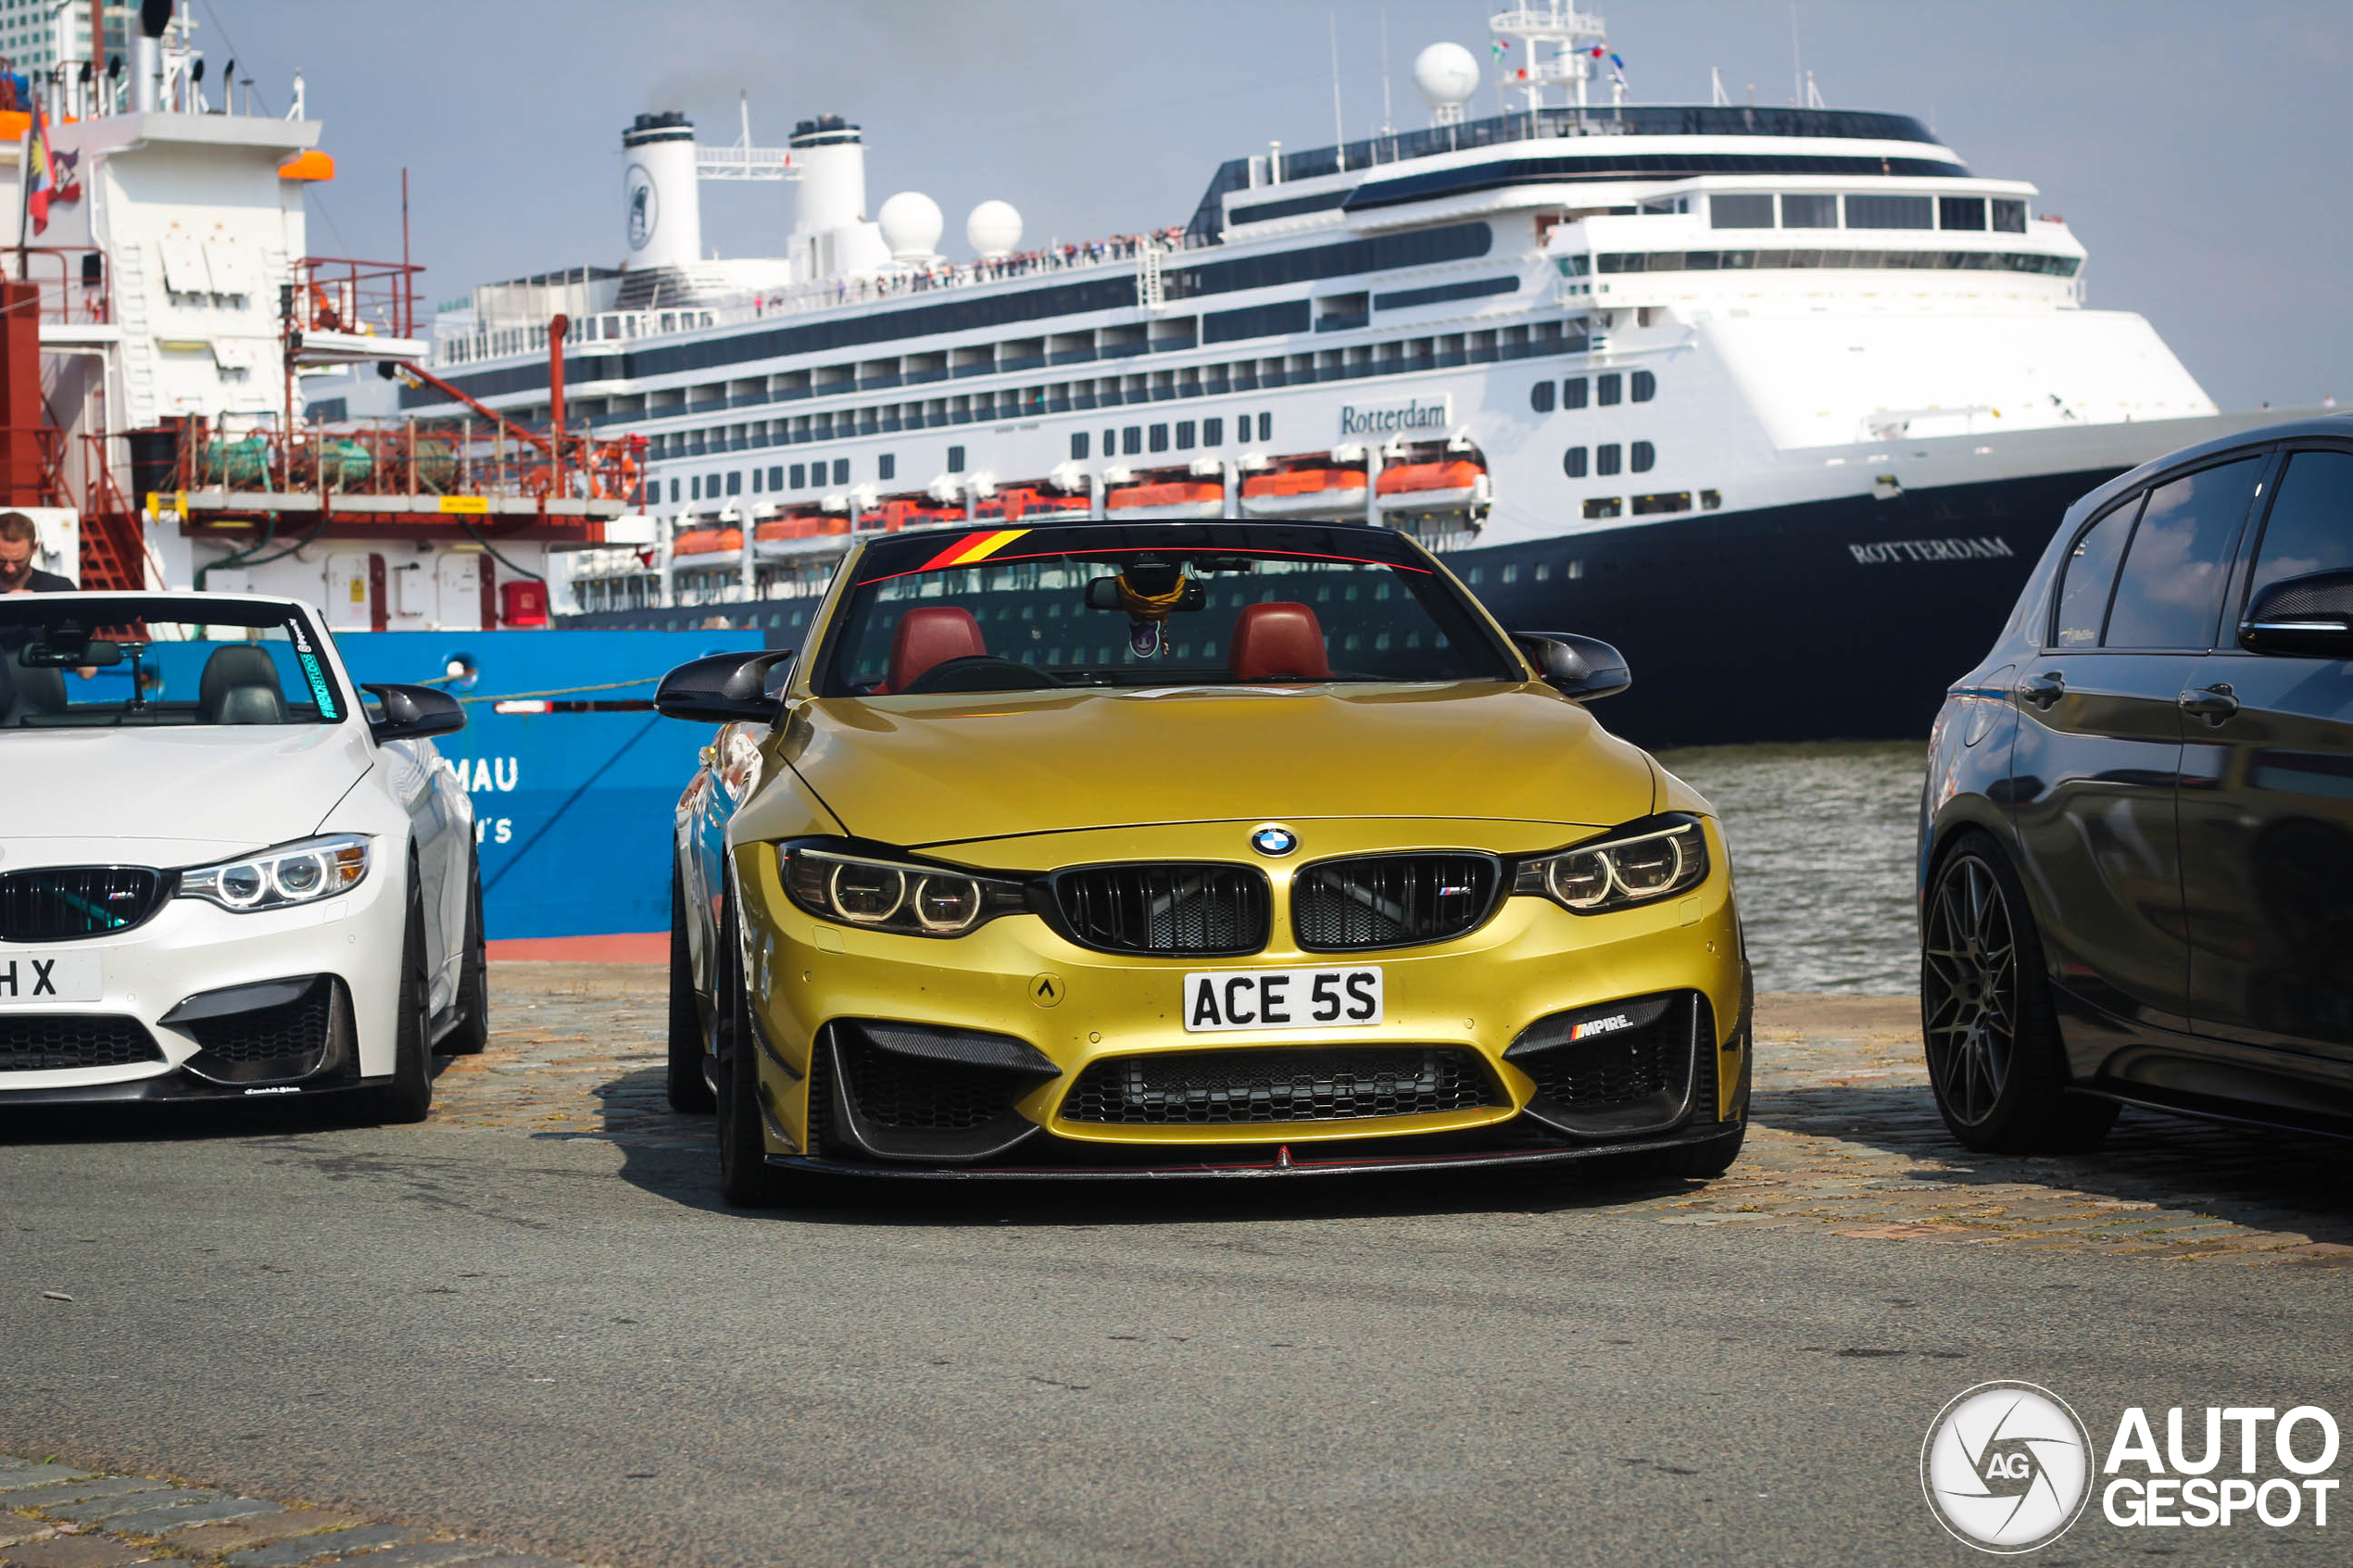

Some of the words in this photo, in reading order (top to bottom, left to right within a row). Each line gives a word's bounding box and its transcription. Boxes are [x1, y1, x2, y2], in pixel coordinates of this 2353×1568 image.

[1341, 399, 1445, 434] Rotterdam
[1849, 535, 2015, 565] ROTTERDAM
[444, 757, 519, 792] MAU
[1192, 975, 1290, 1025] ACE
[1312, 972, 1376, 1021] 5S
